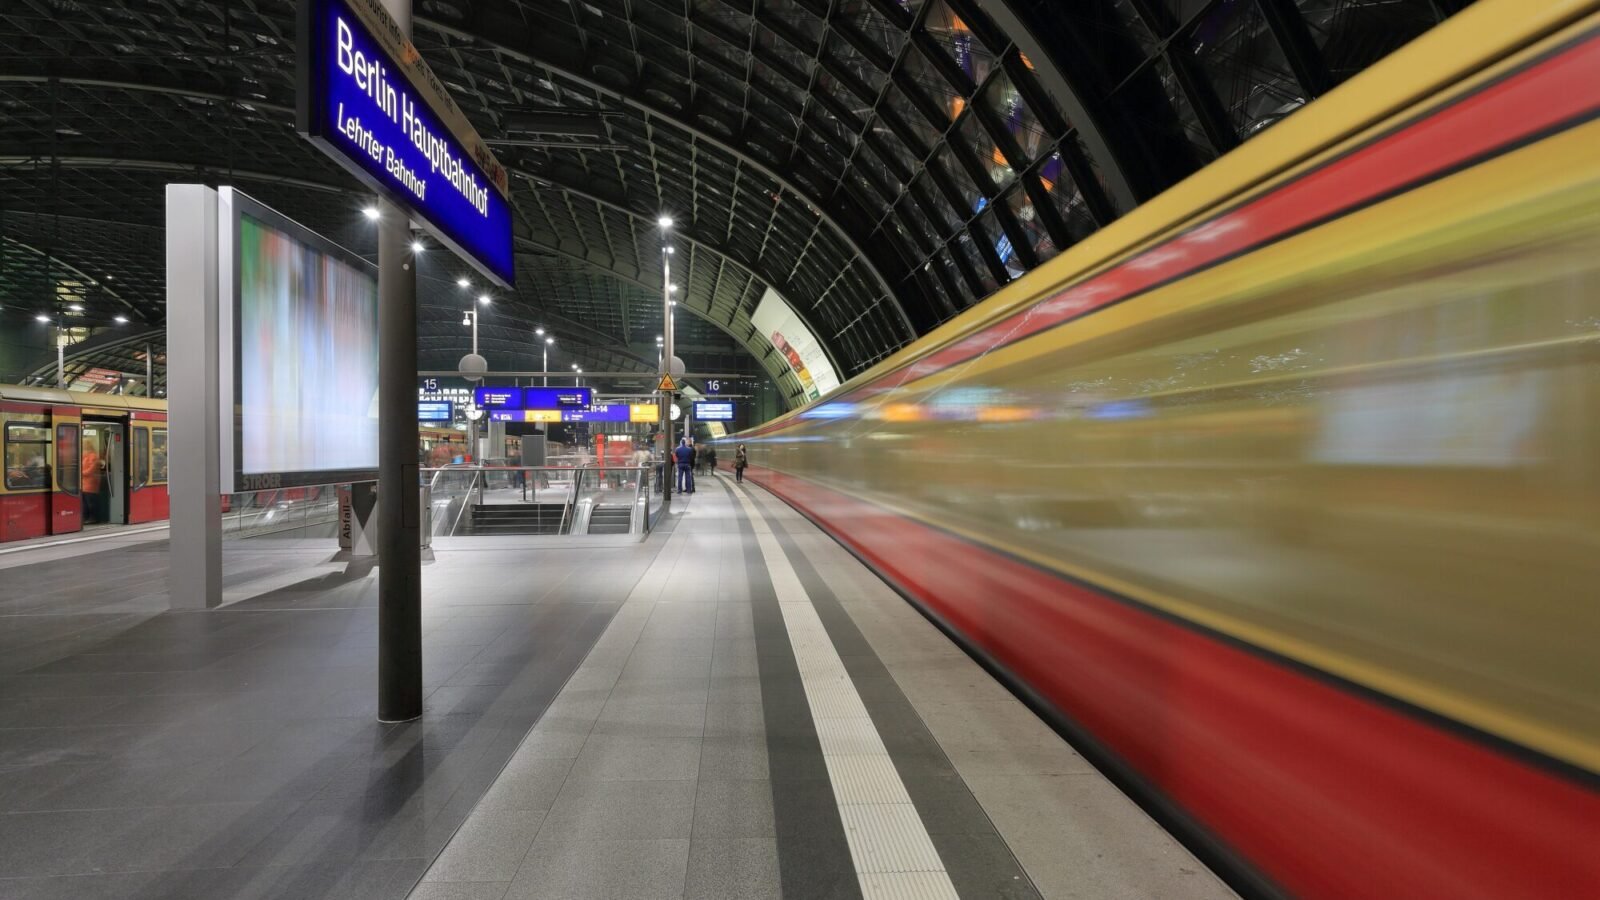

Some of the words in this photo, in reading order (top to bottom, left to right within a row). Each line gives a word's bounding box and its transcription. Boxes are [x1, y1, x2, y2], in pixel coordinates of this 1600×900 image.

[337, 16, 398, 124] Berlin
[402, 92, 488, 218] Hauptbahnhof
[337, 102, 385, 164] Lehrter
[386, 145, 426, 201] Bahnhof
[424, 378, 437, 389] 15
[707, 380, 720, 391] 16
